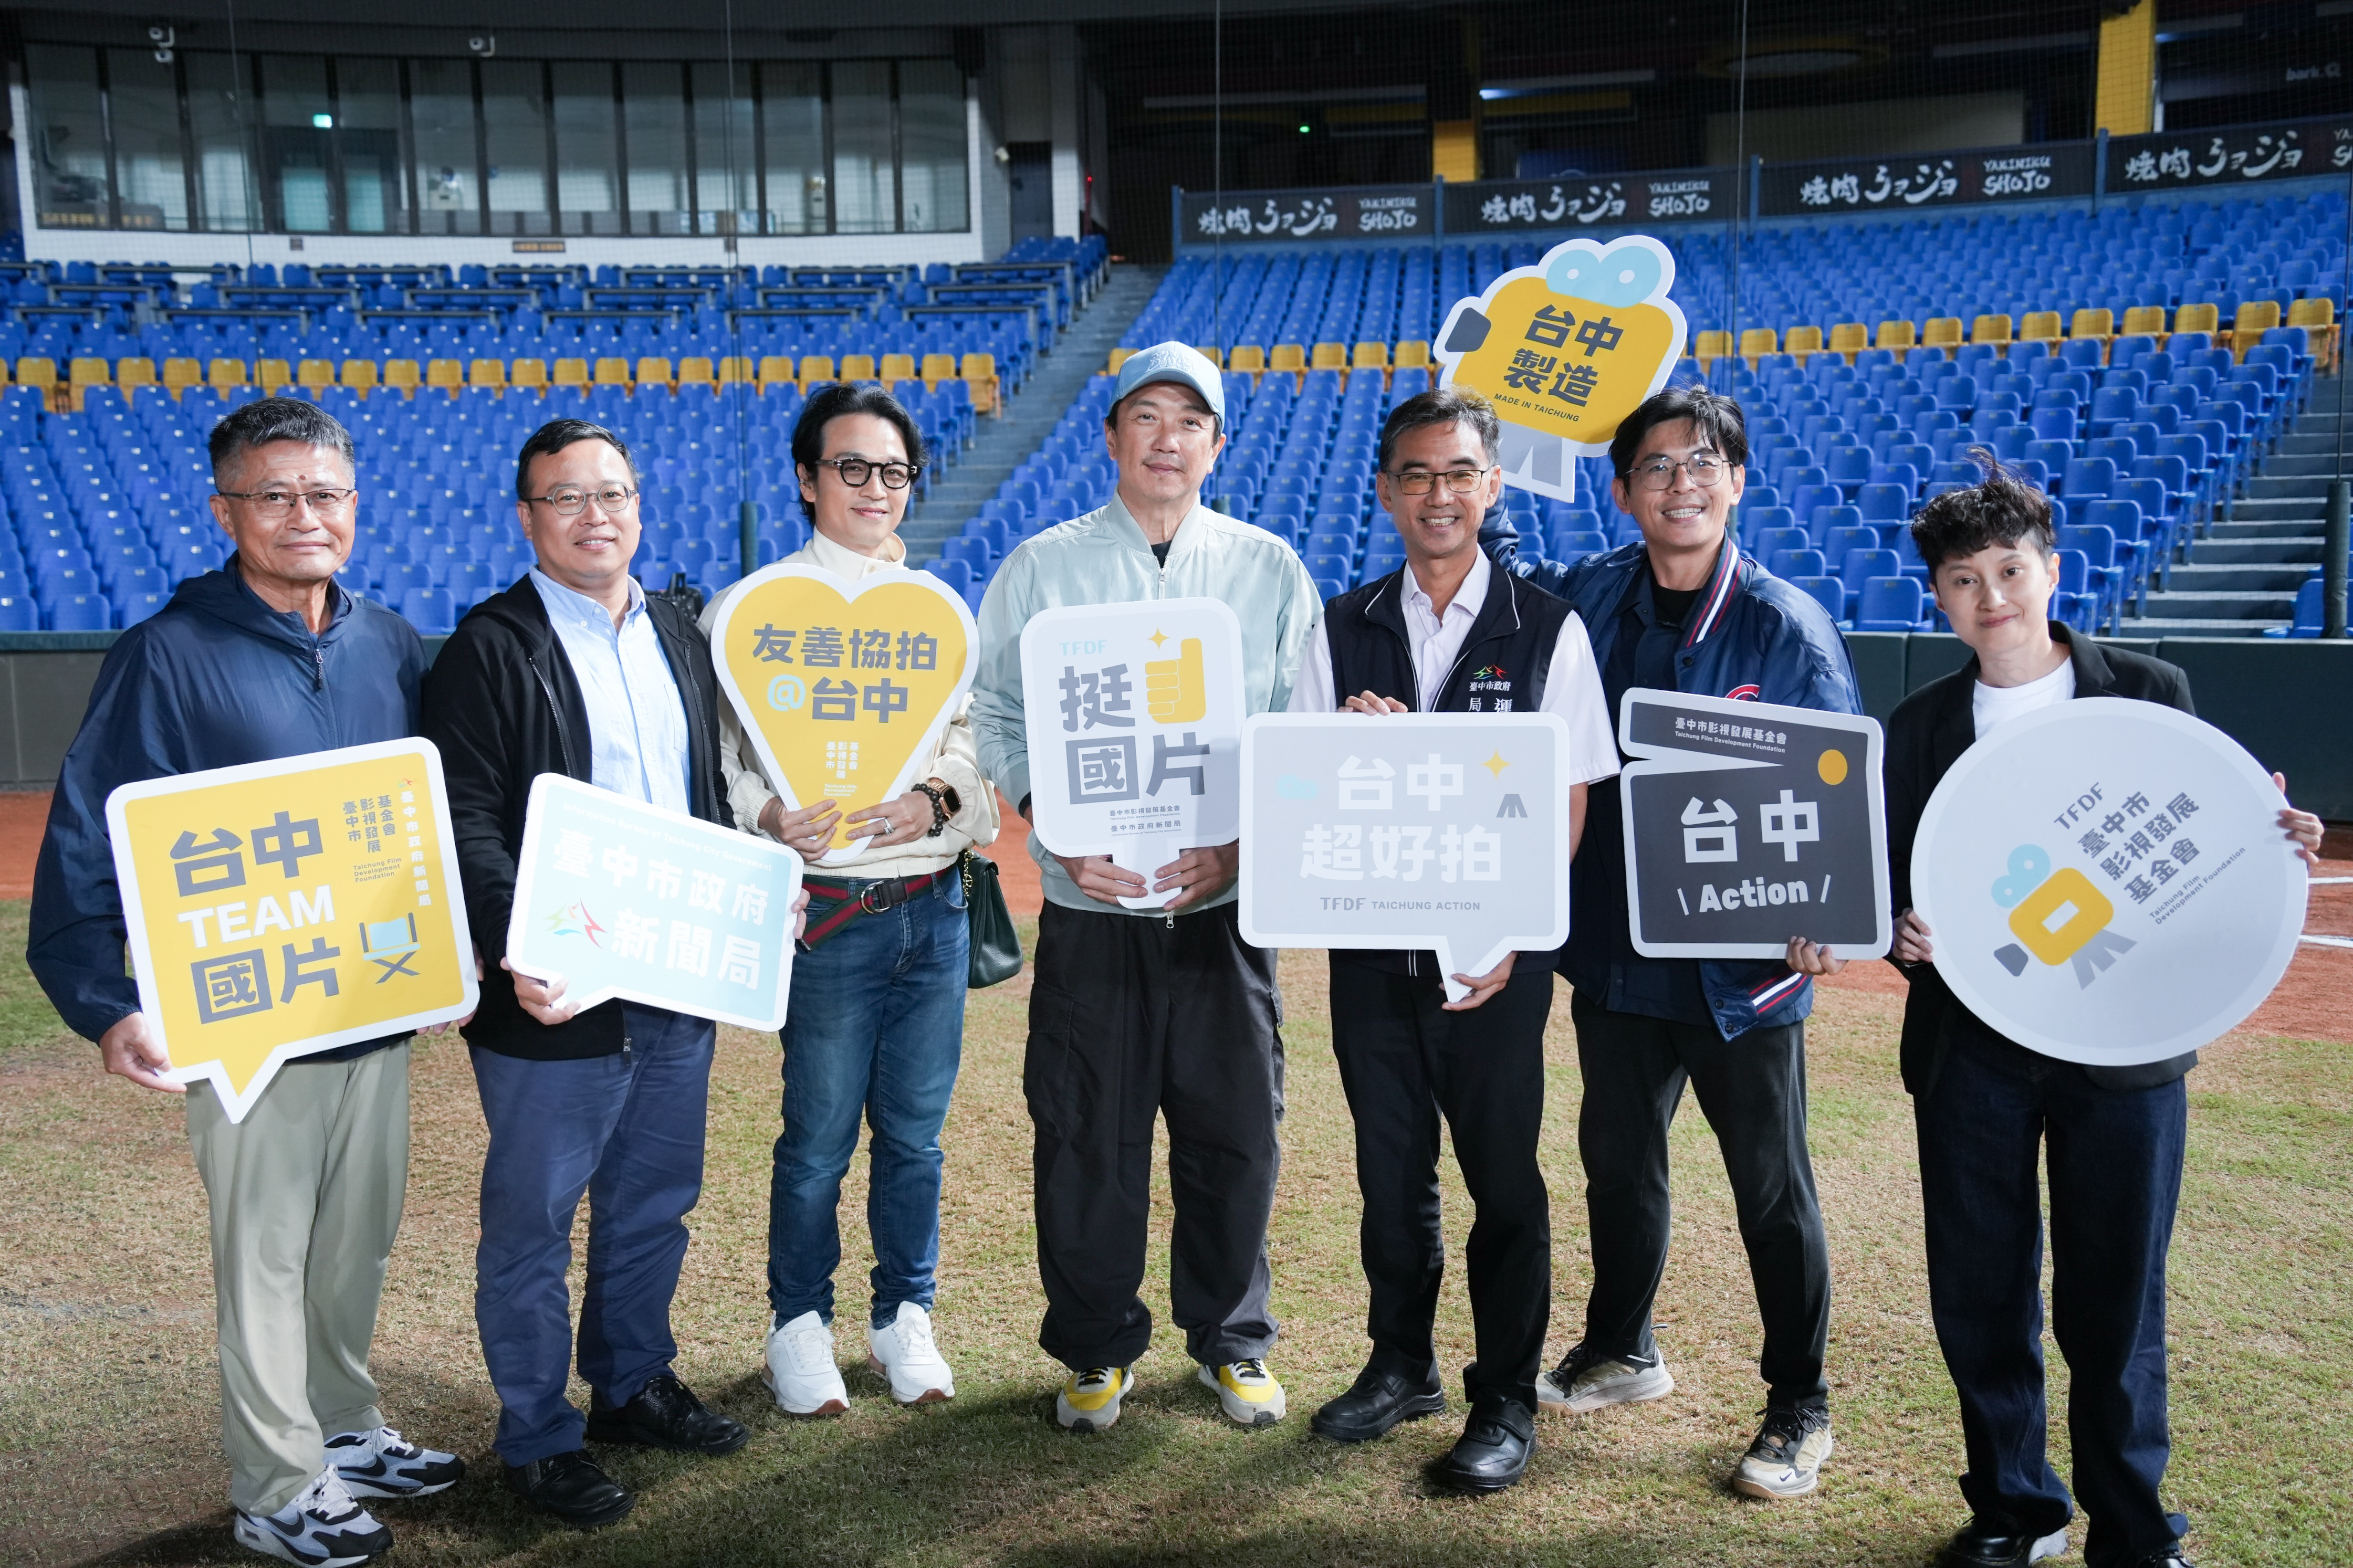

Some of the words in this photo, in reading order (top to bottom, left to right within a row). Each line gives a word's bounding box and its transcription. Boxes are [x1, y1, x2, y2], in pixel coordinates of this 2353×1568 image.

[1648, 193, 1711, 217] SHOJO
[1981, 170, 2051, 196] SHOJO
[1358, 209, 1417, 231] SHOJO
[1524, 304, 1624, 357] 台中
[1503, 348, 1598, 407] 製造
[1494, 393, 1520, 405] MADE
[1534, 404, 1580, 422] TAICHUNG
[752, 623, 937, 670] 友善協拍
[1059, 639, 1107, 656] TFDF
[1059, 664, 1135, 732] 挺
[1468, 697, 1481, 712] 局
[1469, 680, 1511, 691] 臺中市政府
[1675, 717, 1787, 745] 臺中市影視發展基金會
[1675, 731, 1700, 741] Taichung
[1714, 738, 1751, 748] Development
[1753, 743, 1785, 753] Foundation
[1065, 732, 1210, 805] 國片
[1337, 753, 1464, 811] 台中
[343, 801, 361, 841] 臺中市
[360, 797, 381, 853] 影視發展
[378, 795, 395, 836] 基金會
[1110, 805, 1180, 816] 臺中市影視發展基金會
[1111, 820, 1181, 832] 臺中市政府新聞局
[1681, 790, 1819, 863] 台中
[2054, 782, 2103, 829] TFDF
[2077, 791, 2150, 859] 臺中市
[170, 811, 323, 897] 台中
[401, 791, 431, 907] 臺中市政府新聞局
[563, 802, 616, 825] Information
[618, 818, 649, 836] Bureau
[663, 833, 701, 851] Taichung
[704, 845, 720, 857] City
[723, 851, 772, 871] Government
[1300, 824, 1501, 883] 超好拍
[2099, 792, 2200, 881] 影視發展
[353, 860, 385, 870] Taichung
[354, 864, 401, 877] Development
[355, 871, 395, 882] Foundation
[552, 827, 769, 926] 臺中市政府
[2124, 838, 2200, 905] 基金會
[2155, 883, 2203, 924] Development
[2203, 847, 2245, 883] Foundation
[177, 885, 335, 948] TEAM
[1320, 897, 1366, 911] TFDF
[1371, 901, 1431, 910] TAICHUNG
[1436, 901, 1480, 910] ACTION
[1699, 876, 1808, 913] Action
[2149, 890, 2183, 918] Taichung
[2183, 876, 2200, 890] Film
[611, 907, 761, 990] 新聞局
[191, 936, 341, 1025] 國片
